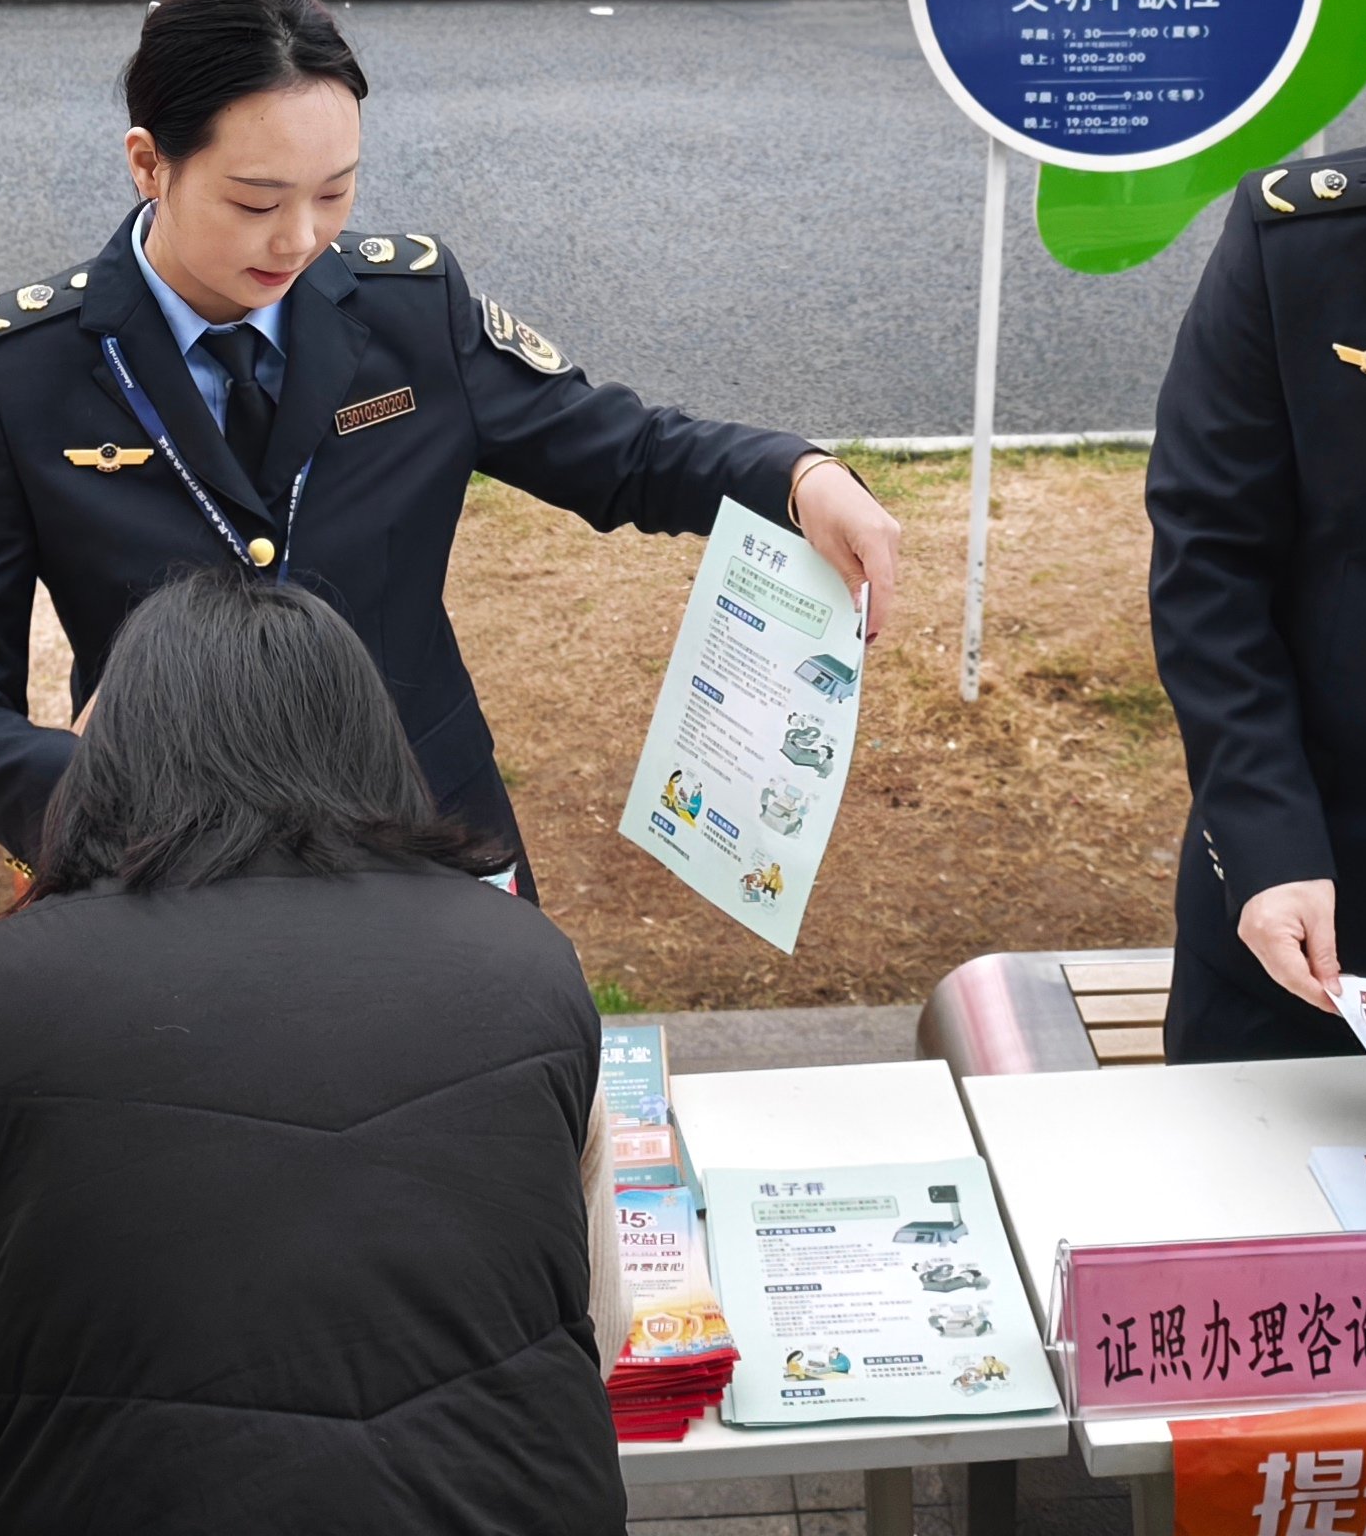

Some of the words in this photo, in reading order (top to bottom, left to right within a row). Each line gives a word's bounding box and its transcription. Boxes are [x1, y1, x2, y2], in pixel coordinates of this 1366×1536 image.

[340, 393, 408, 429] 23010230200
[742, 534, 788, 573] 电子秤
[759, 1182, 826, 1197] 电子秤
